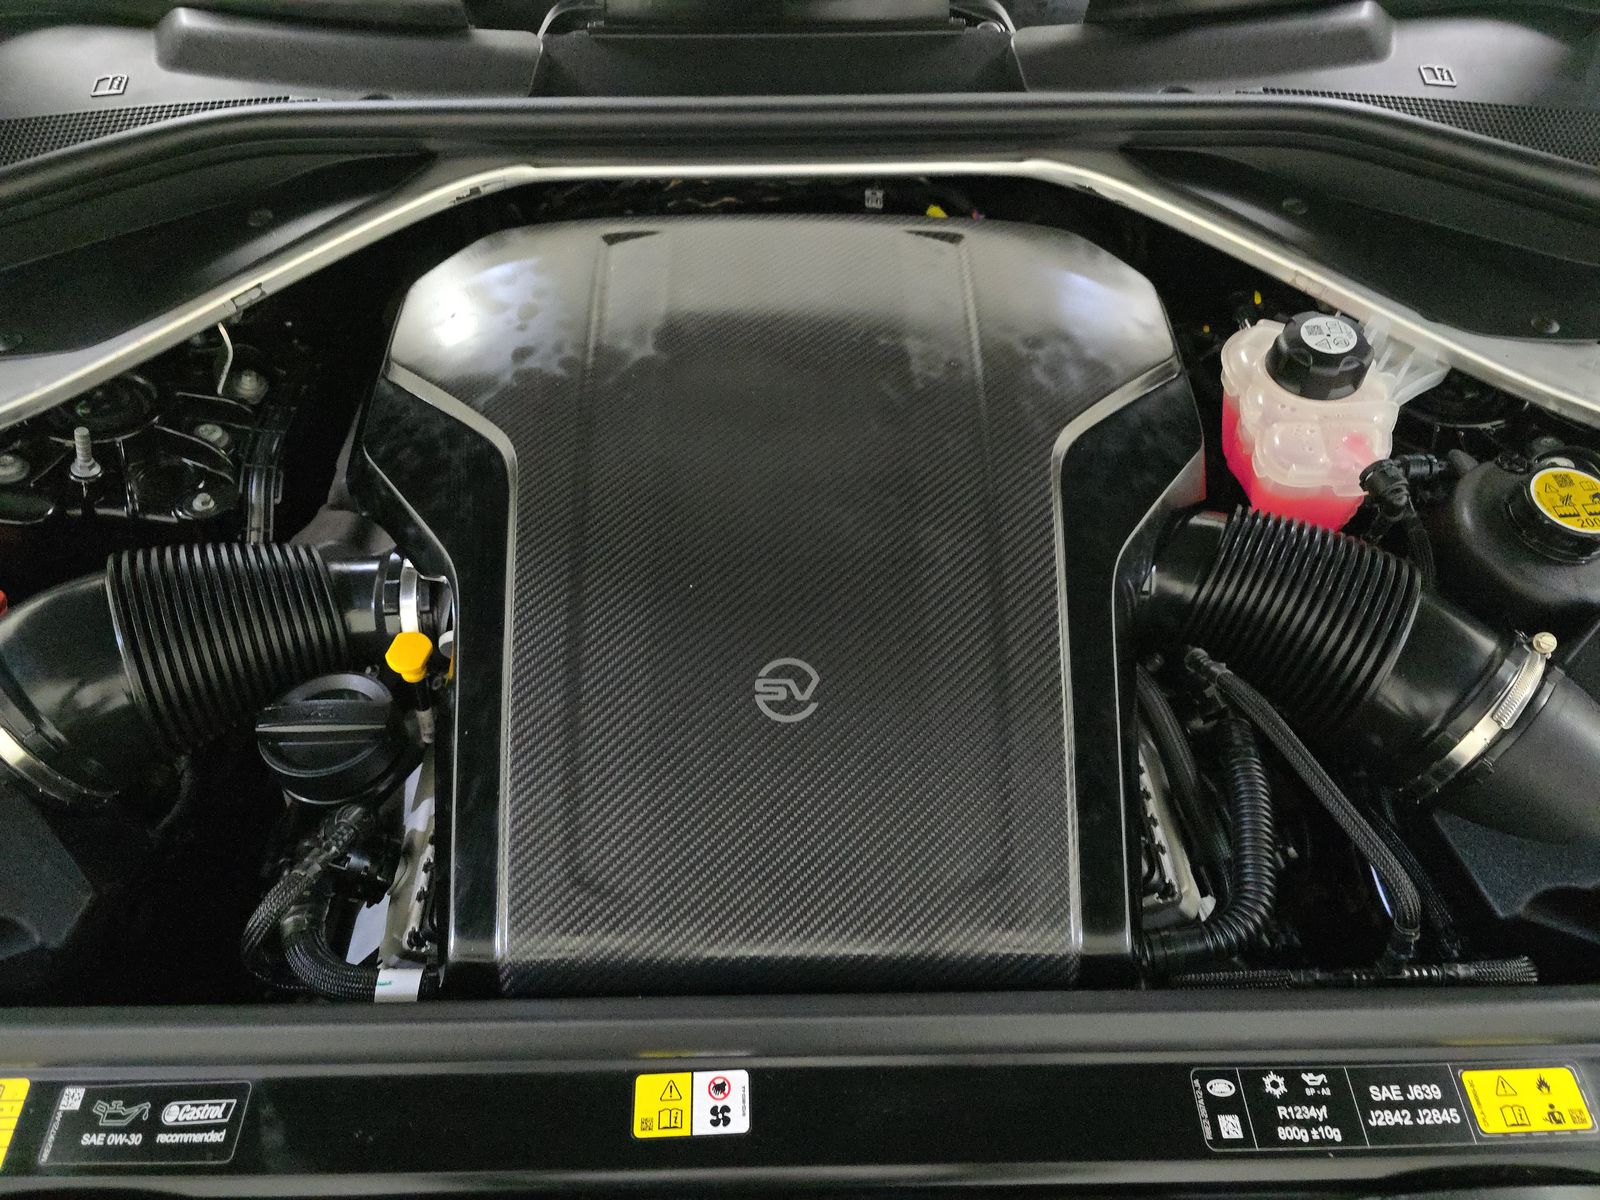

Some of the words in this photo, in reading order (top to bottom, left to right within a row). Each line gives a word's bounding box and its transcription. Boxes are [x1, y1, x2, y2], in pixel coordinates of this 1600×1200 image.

[1369, 1085, 1404, 1101] SAE
[1406, 1084, 1442, 1100] J639
[178, 1102, 227, 1121] Castrol
[1277, 1105, 1328, 1122] R1234yf
[1368, 1109, 1413, 1126] J2842
[1416, 1108, 1461, 1125] J2845
[80, 1133, 106, 1145] SAE
[106, 1133, 143, 1146] 0W-30
[156, 1128, 227, 1143] recommended
[1277, 1126, 1310, 1143] 800g
[1310, 1125, 1342, 1142] ±10g
